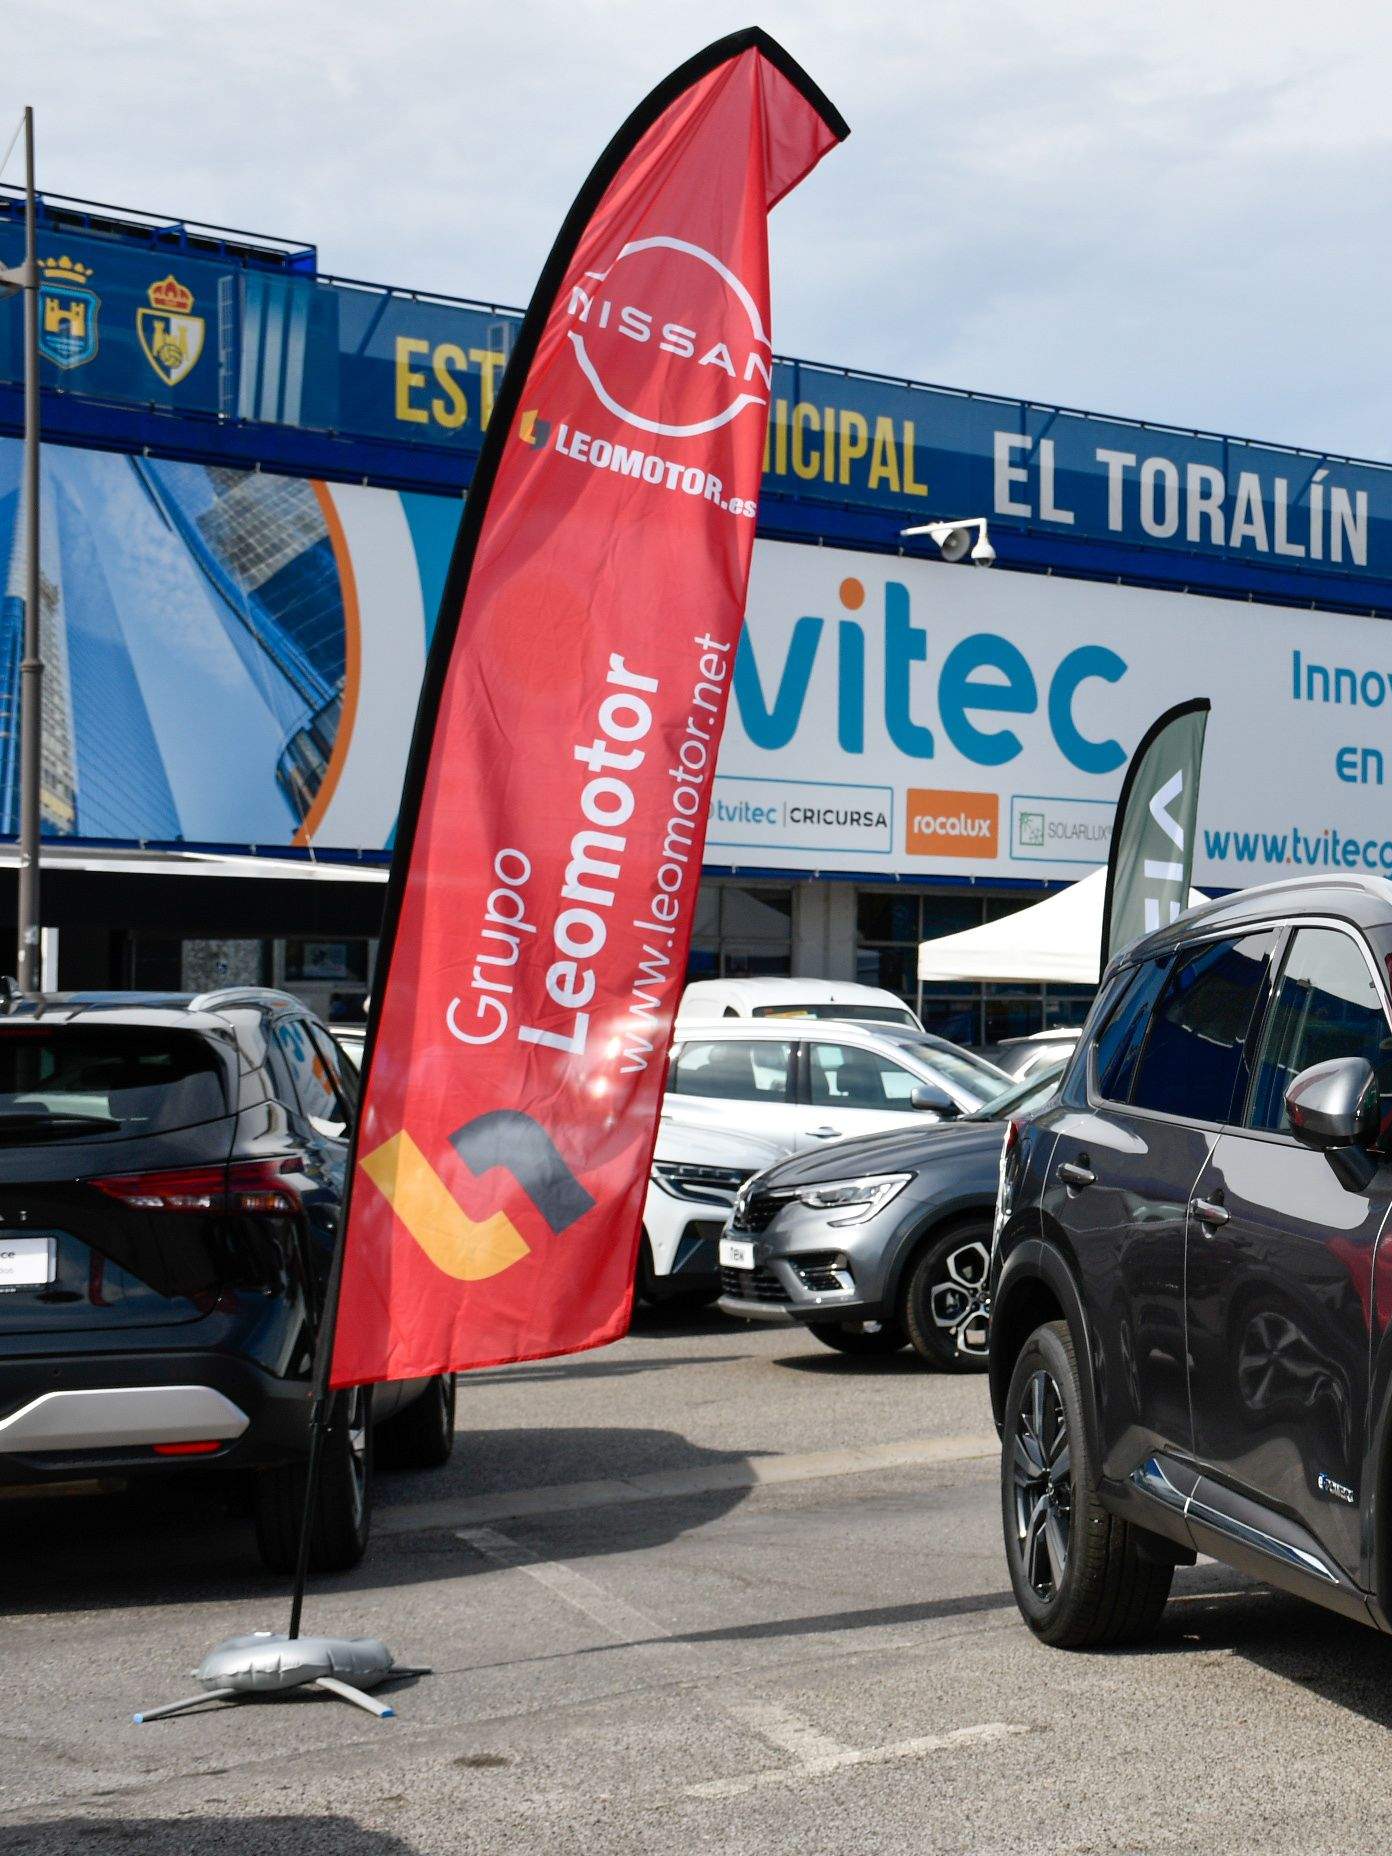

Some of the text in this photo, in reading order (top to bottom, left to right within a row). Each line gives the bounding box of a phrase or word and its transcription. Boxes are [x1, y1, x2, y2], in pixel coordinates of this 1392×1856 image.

[567, 286, 773, 391] NISSAN
[555, 423, 757, 518] LEOMOTOR.es
[993, 430, 1369, 567] EL TORALÍN
[717, 802, 888, 829] tvitec CRICURSA
[1335, 746, 1384, 785] en
[518, 652, 660, 1056] Leomotor
[619, 632, 731, 1074] www.leomotor.net
[913, 813, 991, 838] rocalux
[446, 847, 537, 1046] Grupo
